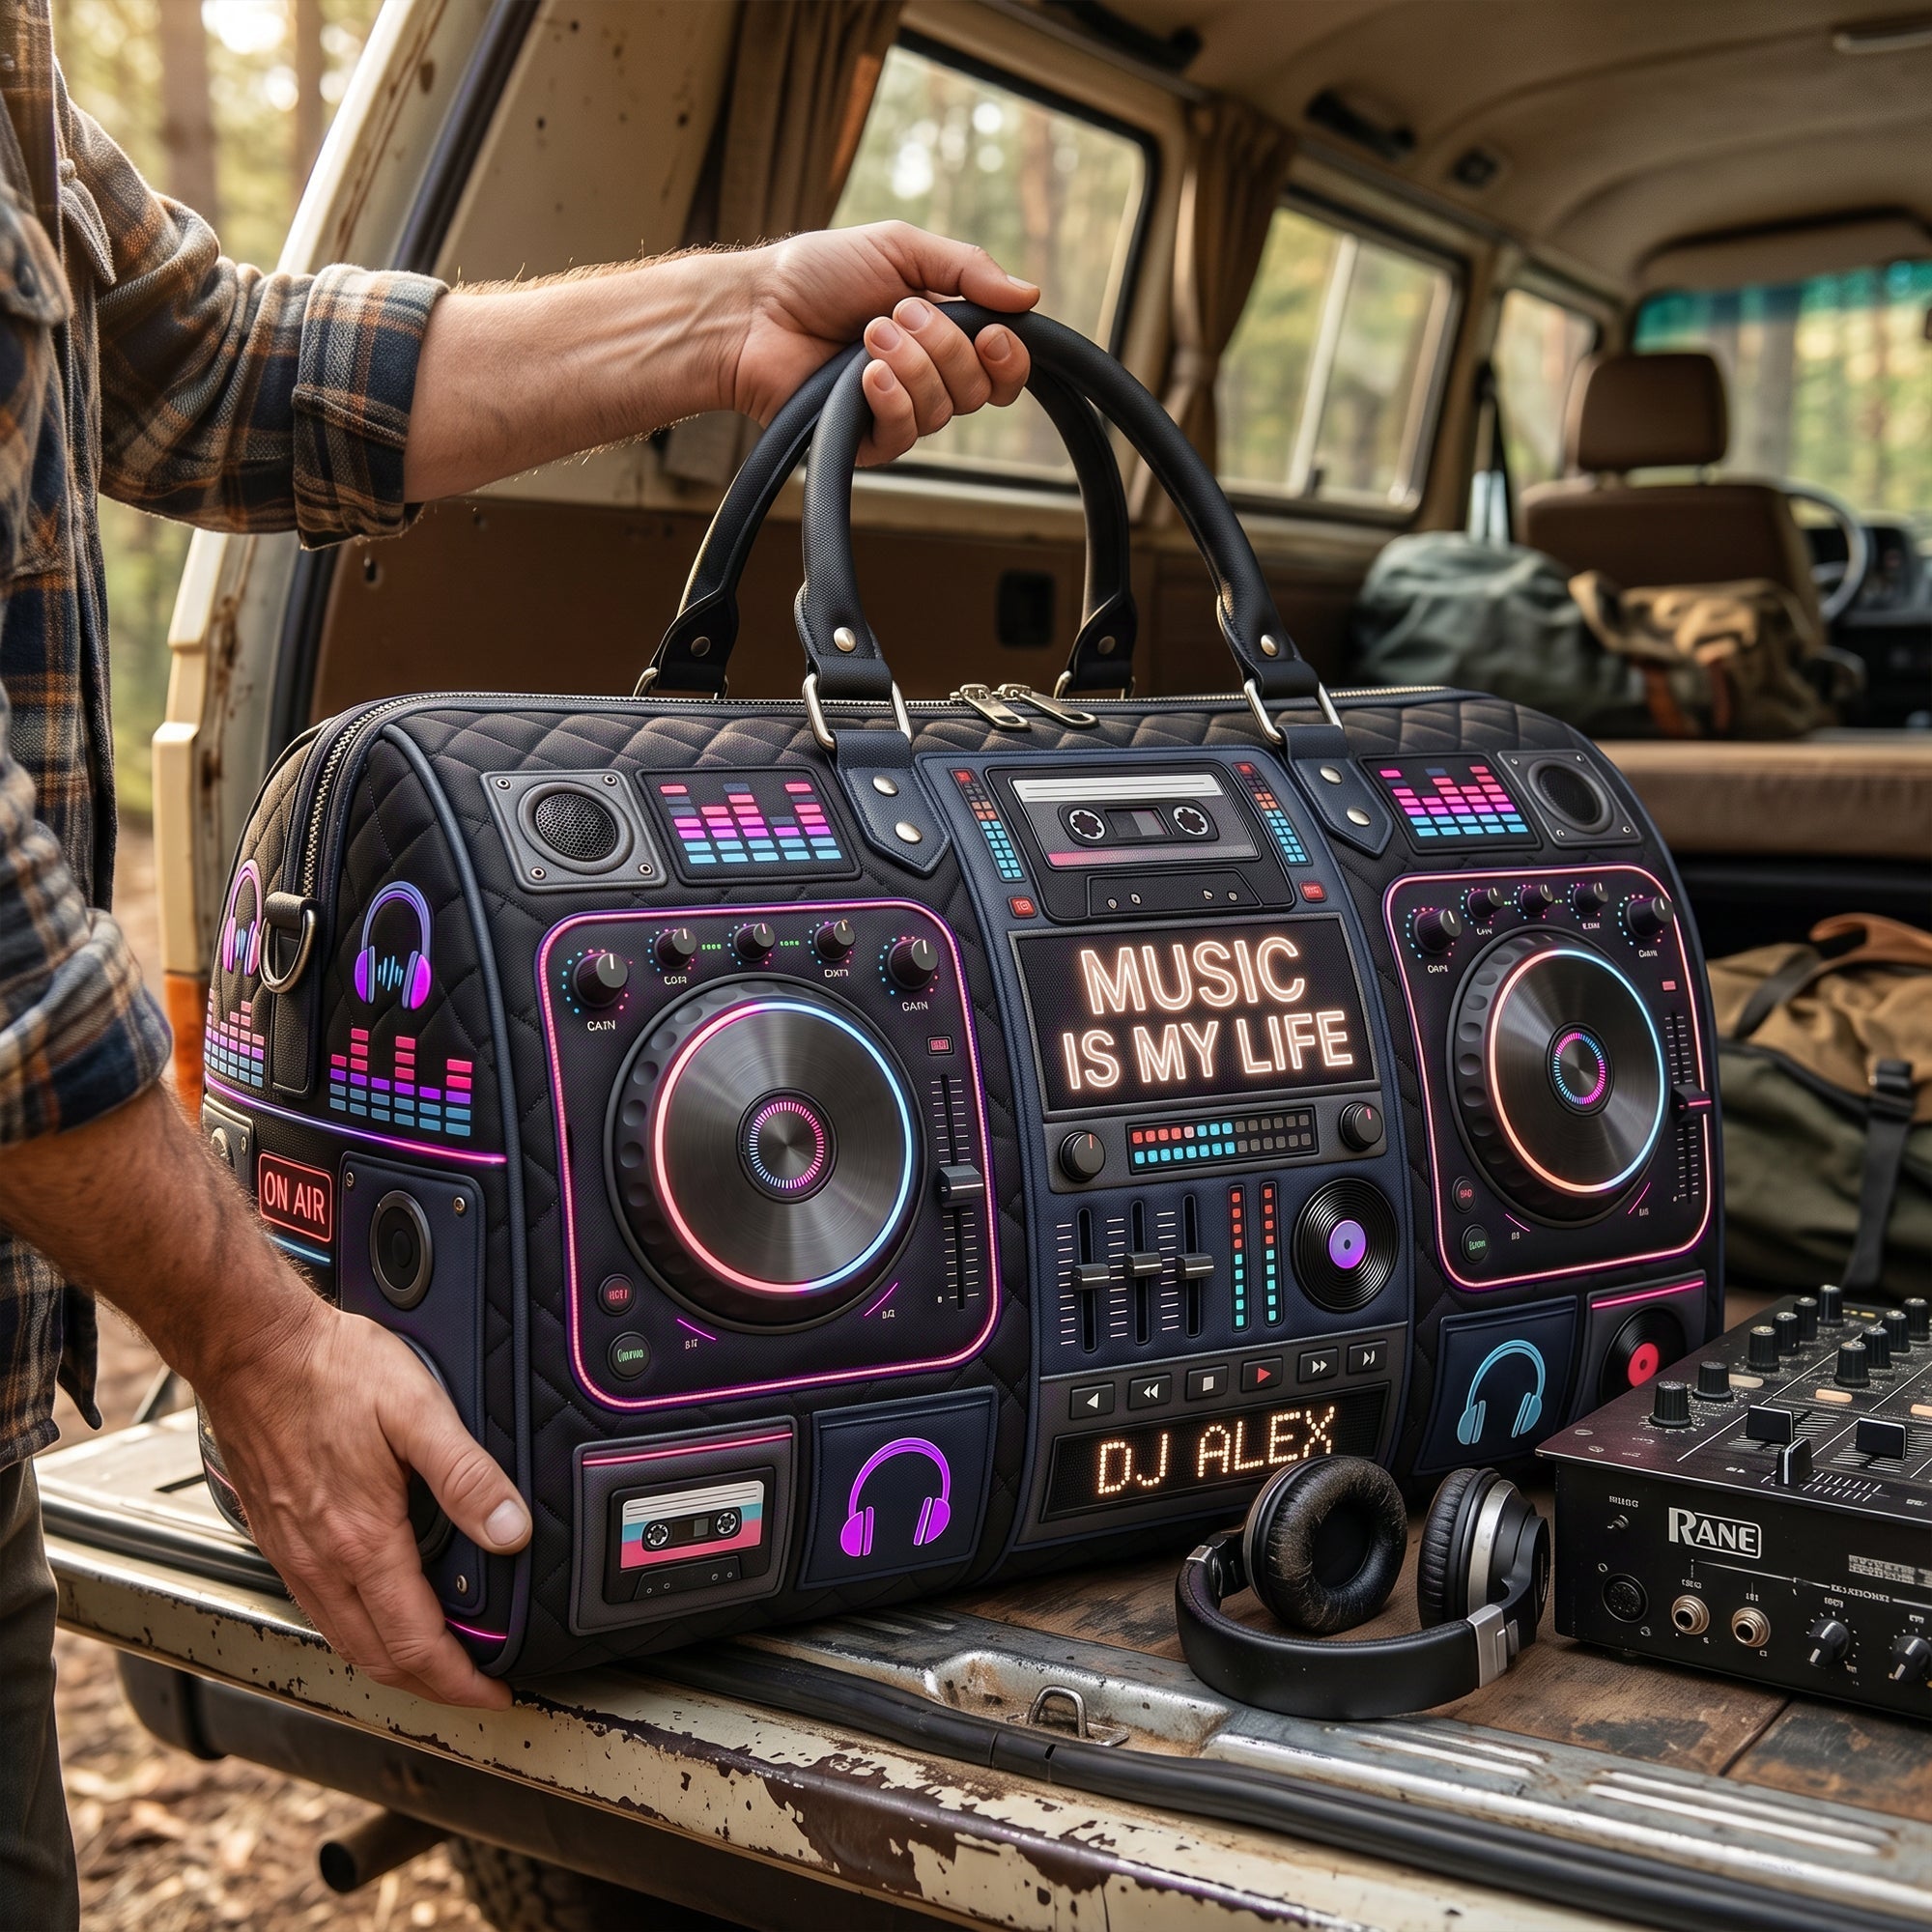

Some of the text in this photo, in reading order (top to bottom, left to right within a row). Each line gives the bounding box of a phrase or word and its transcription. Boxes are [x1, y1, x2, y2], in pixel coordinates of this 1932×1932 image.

[1081, 937, 1305, 1014] MUSIC
[1063, 1010, 1353, 1090] IS MY LIFE
[264, 1171, 326, 1224] ON AIR
[1097, 1406, 1335, 1494] DJ ALEX
[1668, 1507, 1758, 1554] RANE
